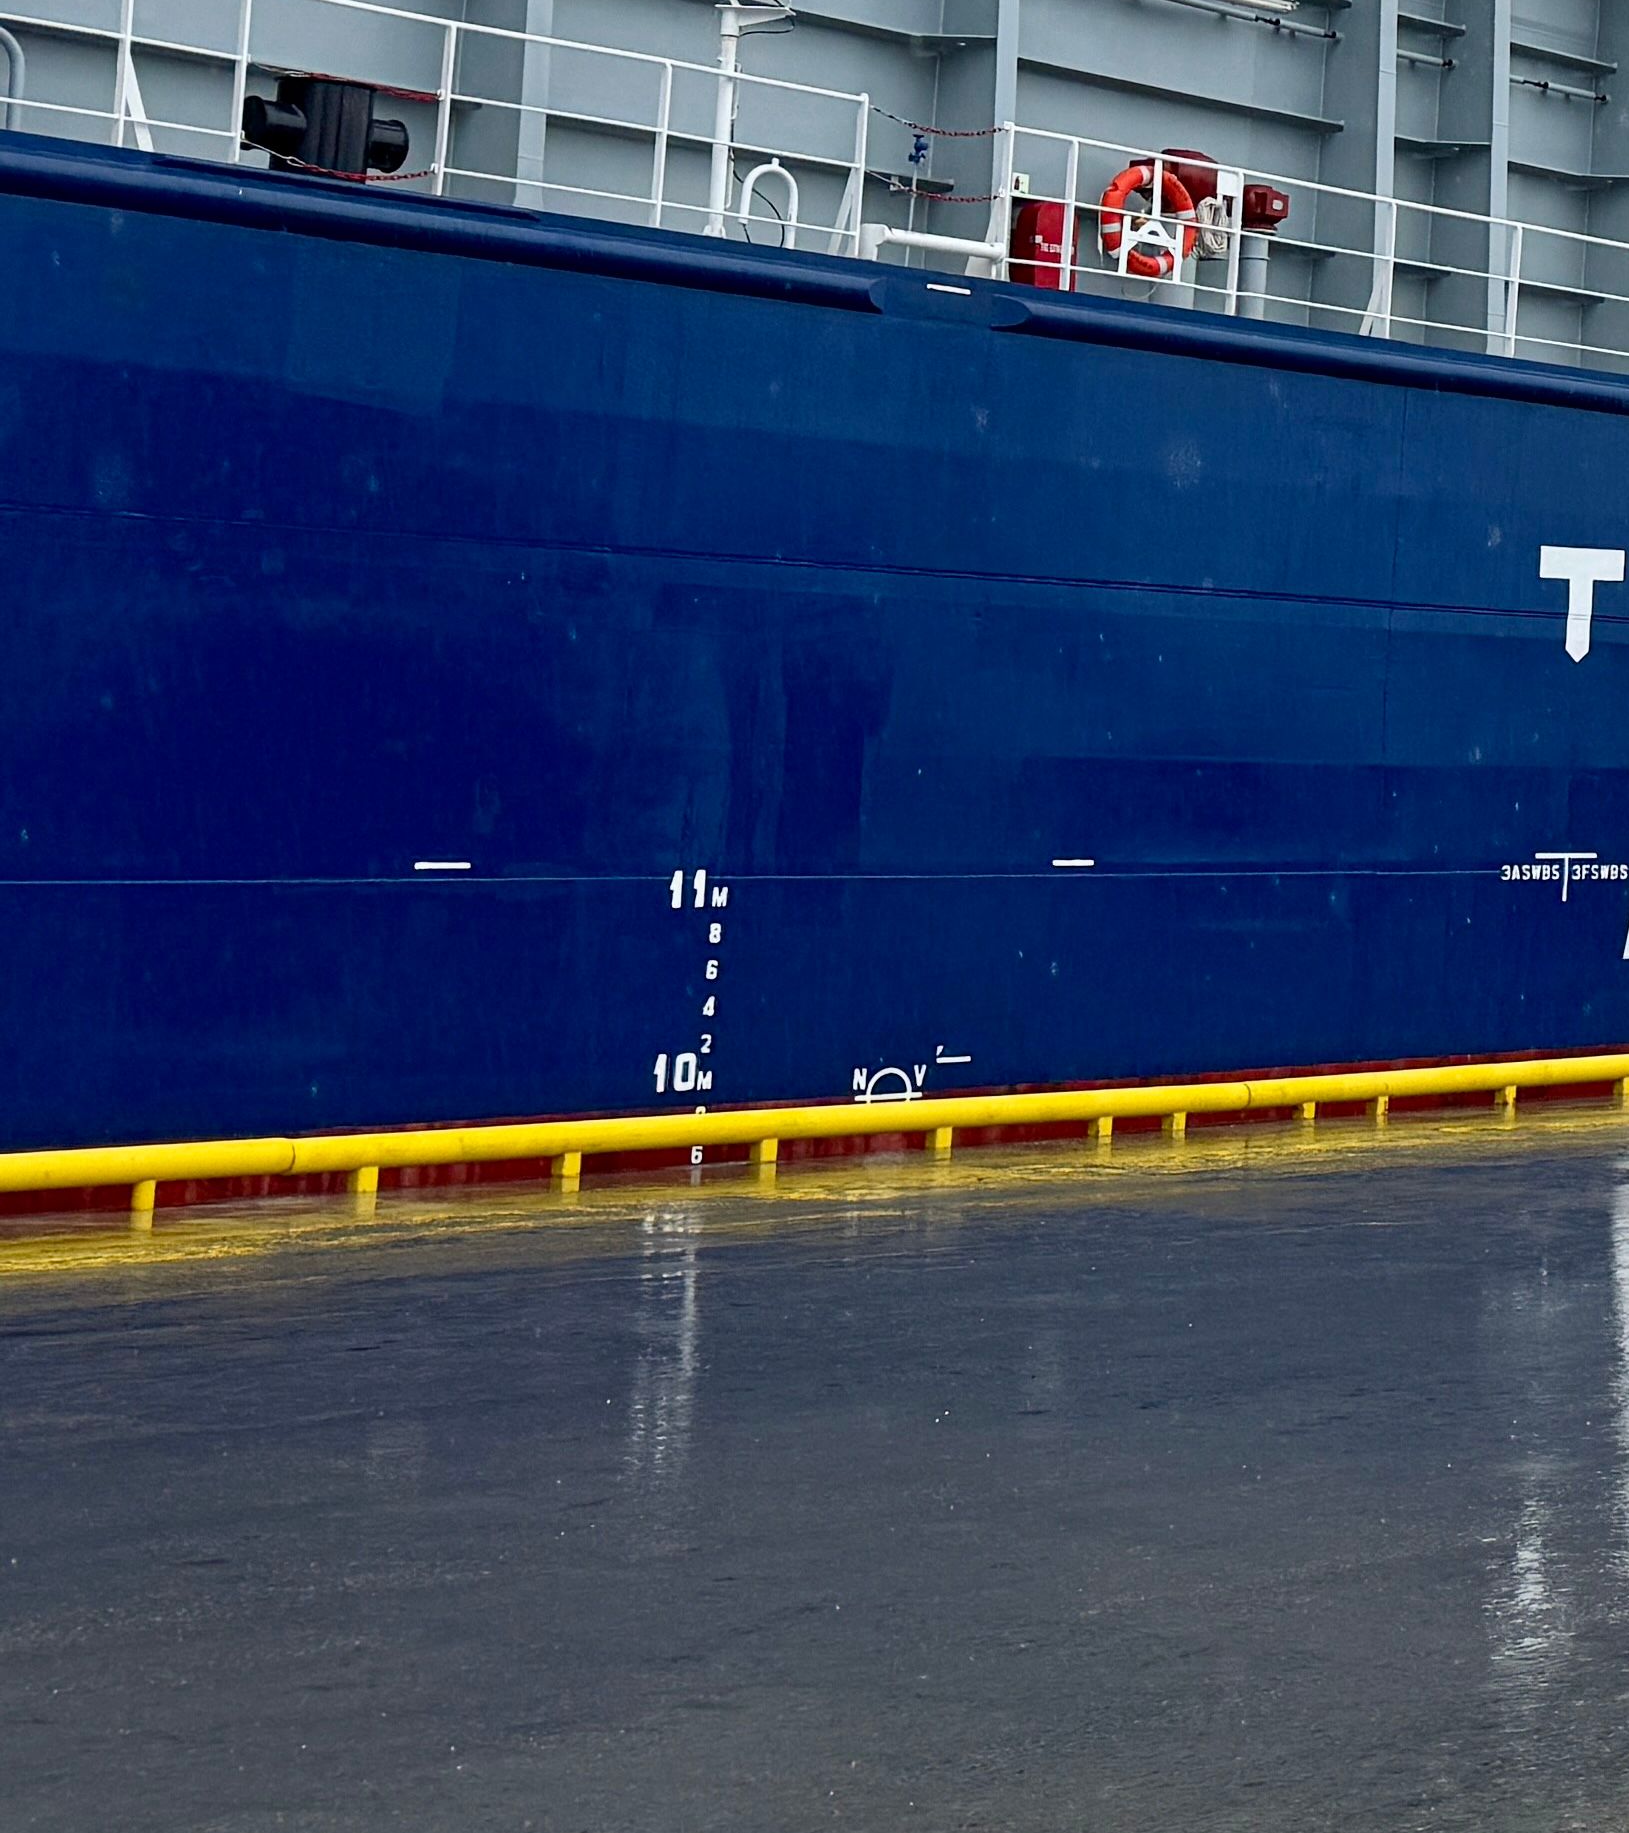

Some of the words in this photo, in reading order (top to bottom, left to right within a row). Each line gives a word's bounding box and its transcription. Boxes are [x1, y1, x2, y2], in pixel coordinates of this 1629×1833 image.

[1501, 864, 1560, 881] 3ASWBS
[1571, 864, 1629, 881] 3FSWBS
[709, 923, 722, 944] 8
[706, 960, 718, 980] 6
[702, 997, 715, 1017] 4
[701, 1035, 712, 1054] 2
[690, 1145, 704, 1165] 6
